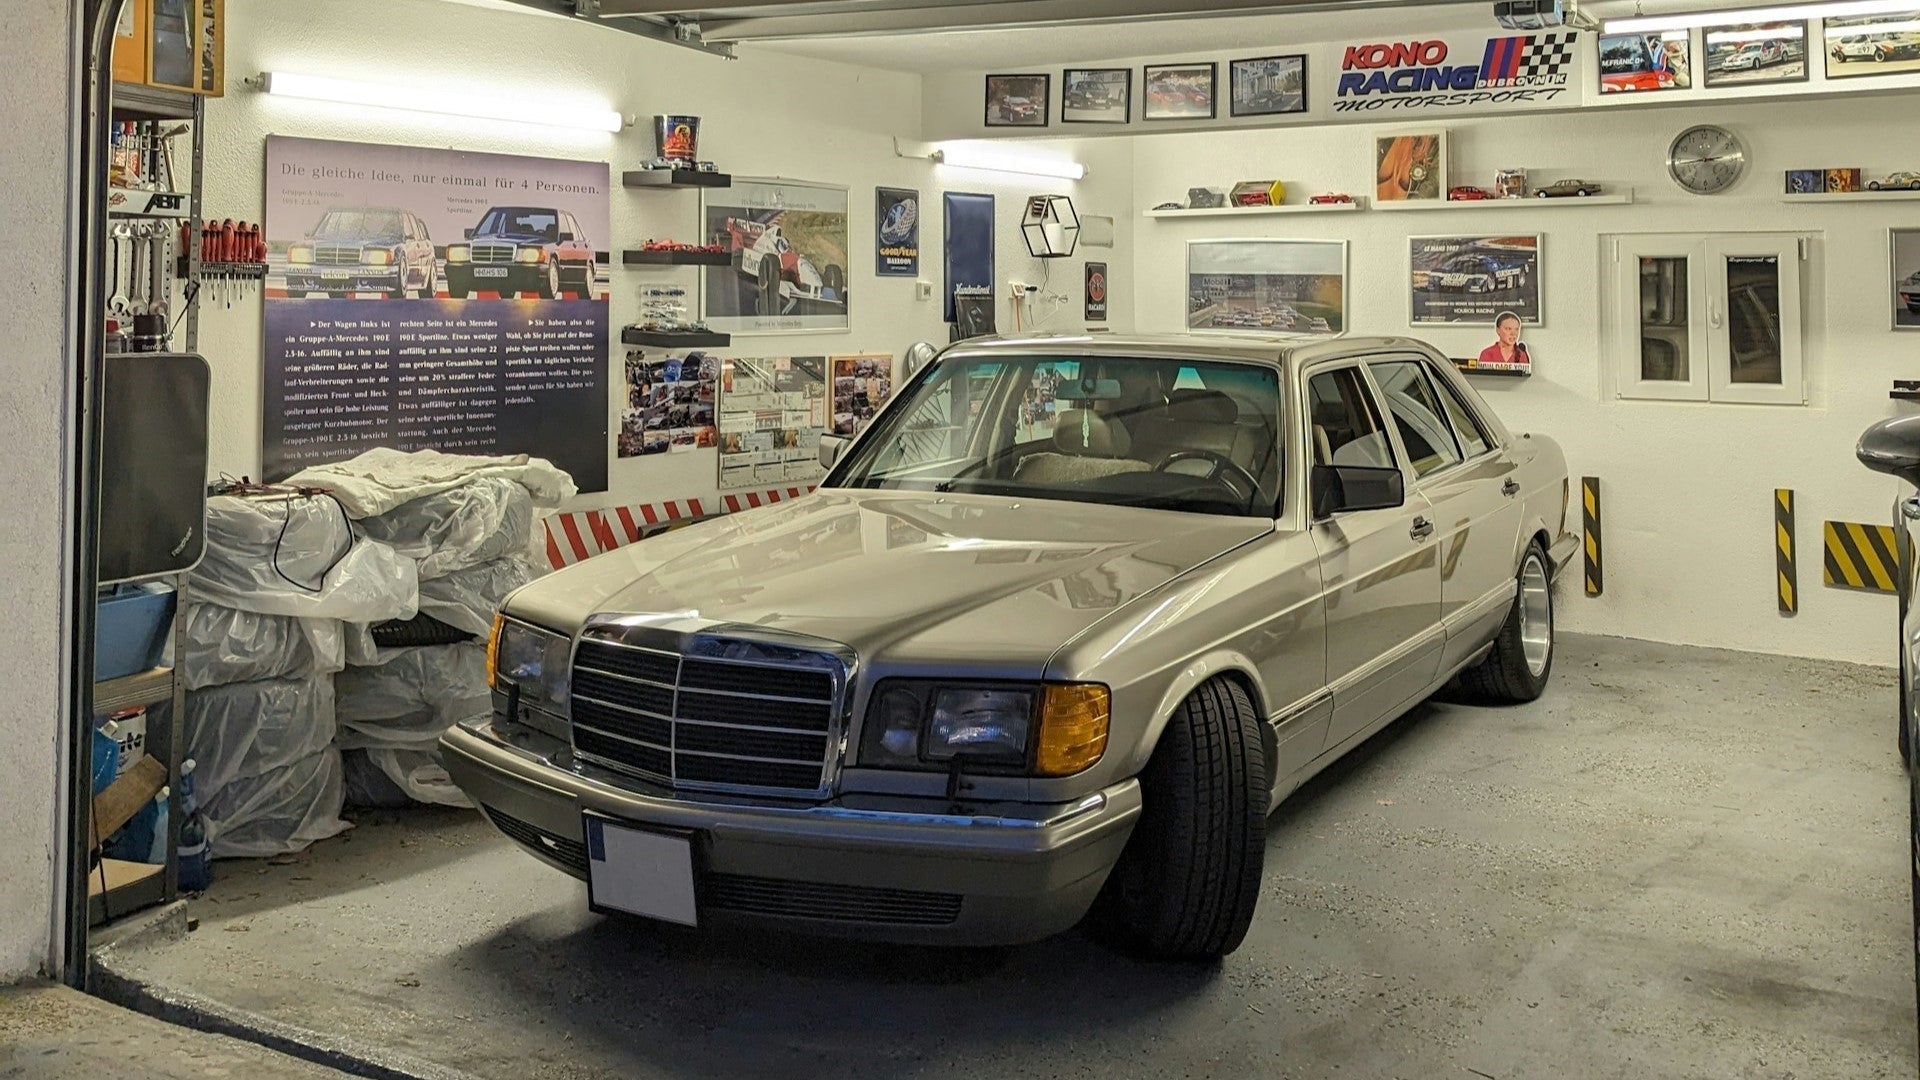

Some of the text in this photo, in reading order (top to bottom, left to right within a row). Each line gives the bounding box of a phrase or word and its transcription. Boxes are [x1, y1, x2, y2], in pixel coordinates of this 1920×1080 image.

[1342, 41, 1448, 70] KONO
[1338, 66, 1479, 96] RACING
[1477, 74, 1567, 89] DUBROVNIK
[1334, 88, 1566, 111] MOTORSPORT
[282, 163, 600, 194] Die gleiche Idee, nur einmal für 4 Personen.
[335, 321, 356, 329] Wagen
[285, 335, 295, 343] ein
[300, 334, 368, 344] Gruppe-A-Mercedes
[474, 333, 497, 341] weniger
[522, 345, 538, 353] Sport
[285, 364, 301, 372] seine
[414, 360, 444, 369] geringere
[471, 399, 496, 407] dagegen
[363, 404, 388, 412] Leistung
[433, 427, 448, 435] Auch
[467, 425, 496, 433] Mercedes
